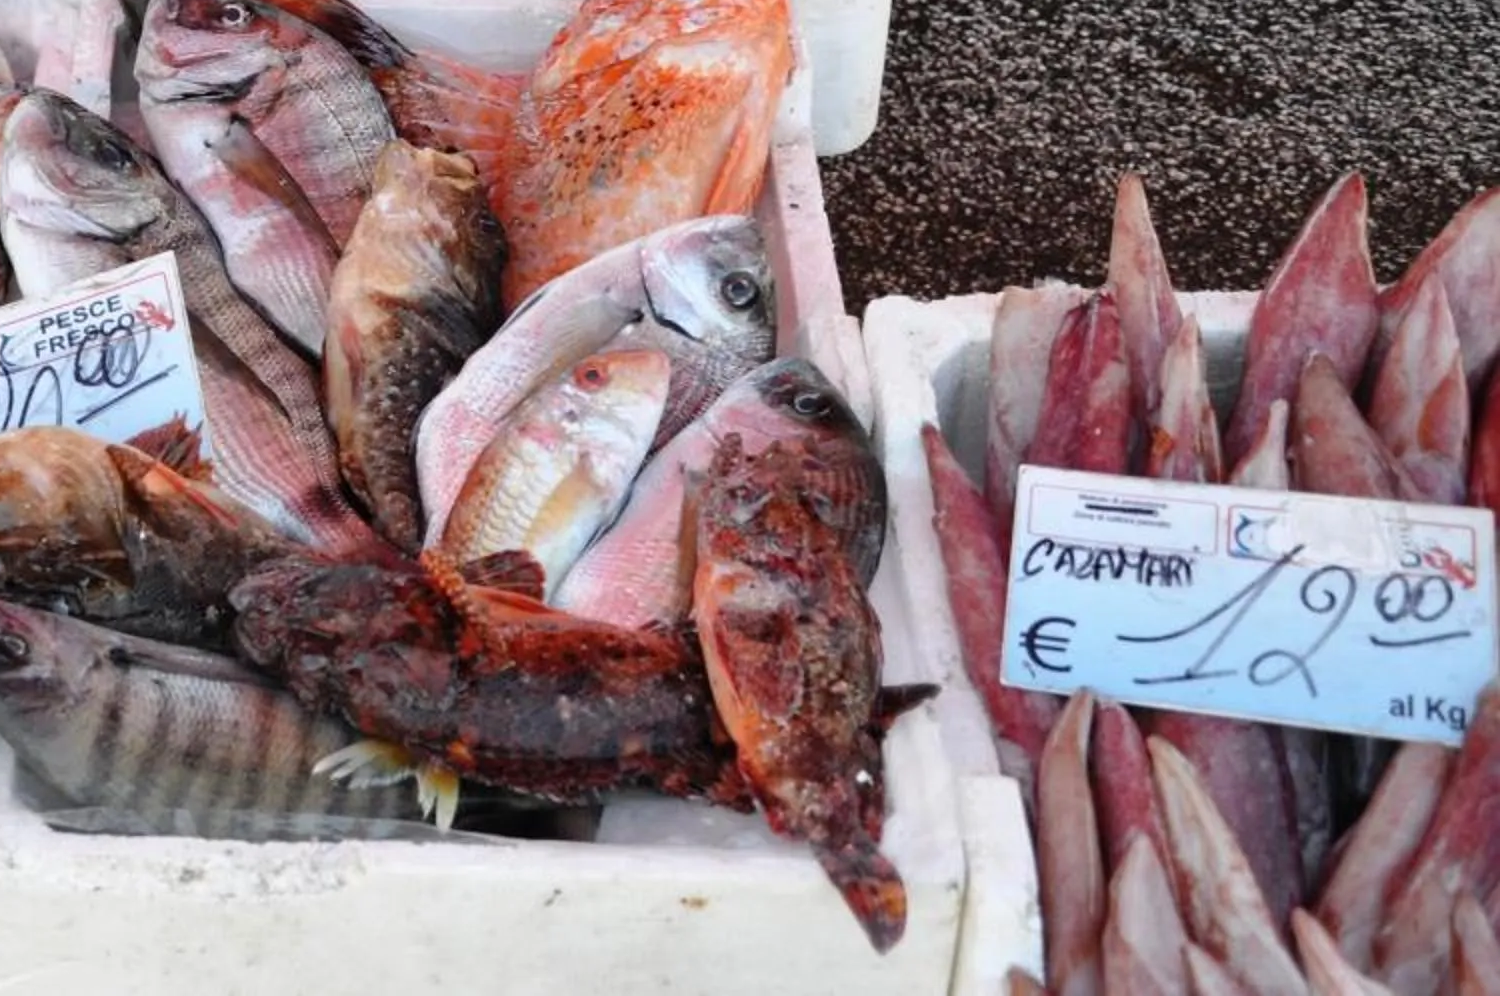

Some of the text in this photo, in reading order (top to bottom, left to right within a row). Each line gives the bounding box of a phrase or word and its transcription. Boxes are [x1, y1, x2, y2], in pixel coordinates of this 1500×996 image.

[39, 294, 124, 335] PESCE
[33, 312, 136, 359] FRESCO
[1389, 694, 1467, 732] al Kg
